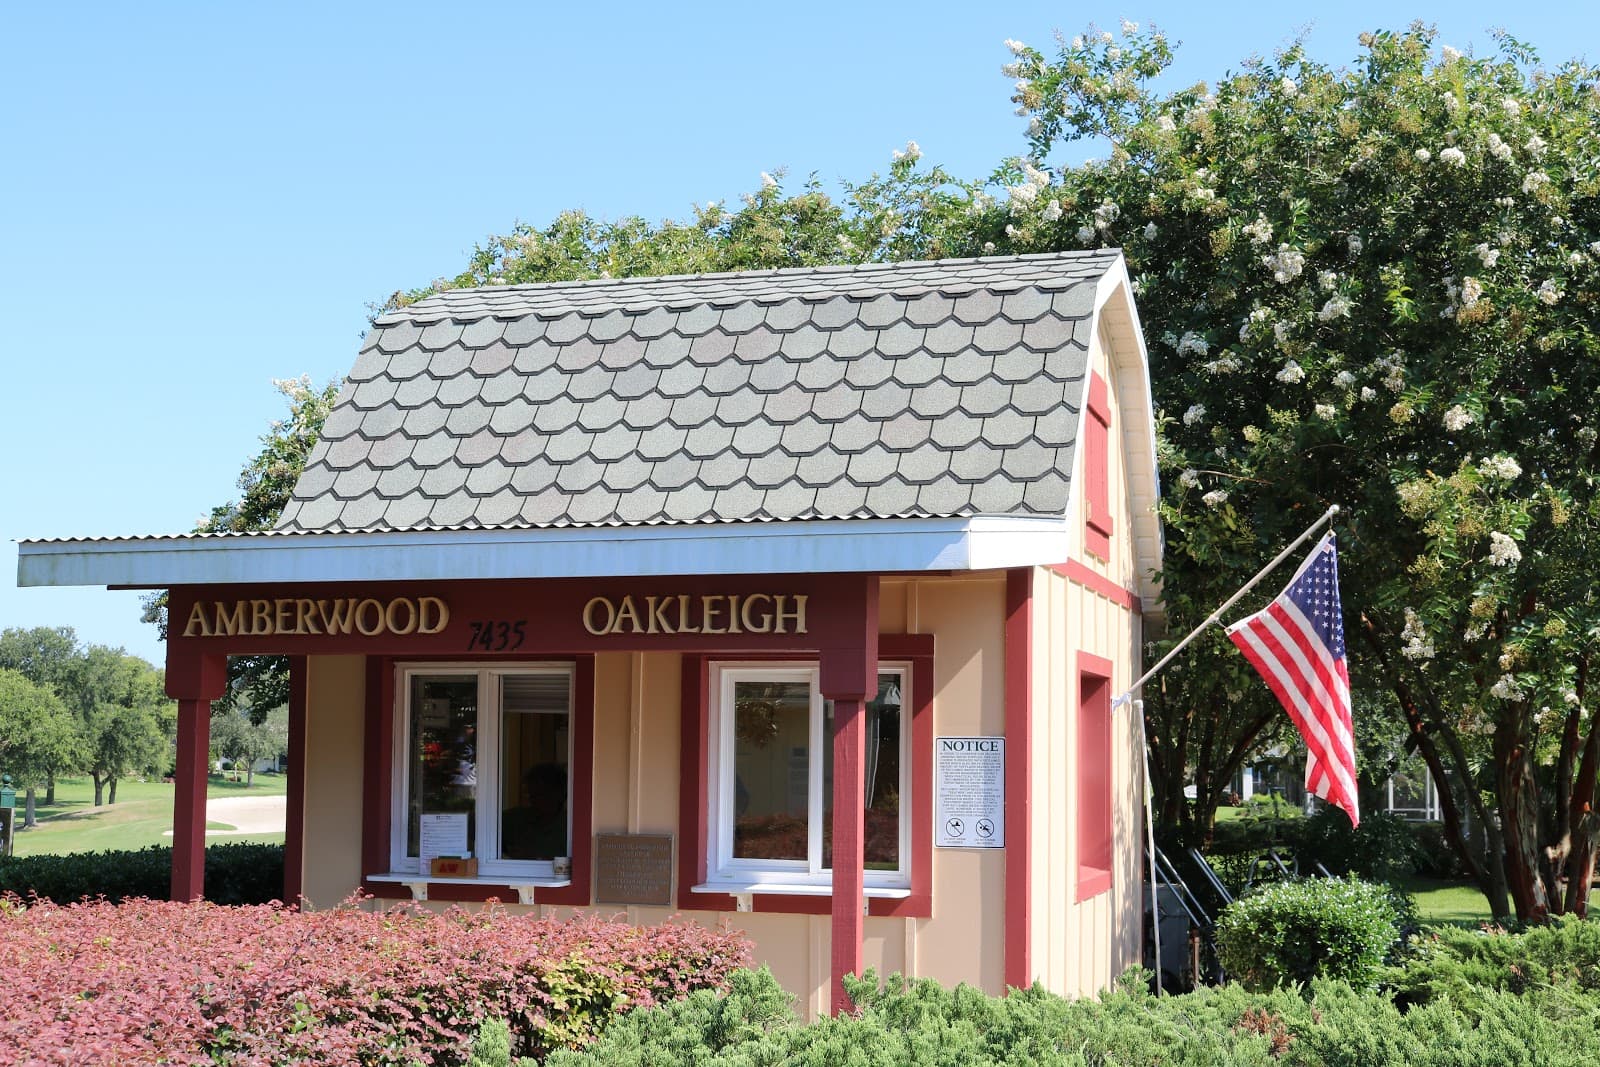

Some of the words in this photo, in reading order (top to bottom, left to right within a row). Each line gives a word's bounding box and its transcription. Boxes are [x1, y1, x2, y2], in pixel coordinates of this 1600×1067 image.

[182, 597, 450, 637] AMBERWOOD
[582, 593, 809, 636] OAKLEIGH
[468, 620, 527, 651] 7435
[942, 740, 999, 752] NOTICE
